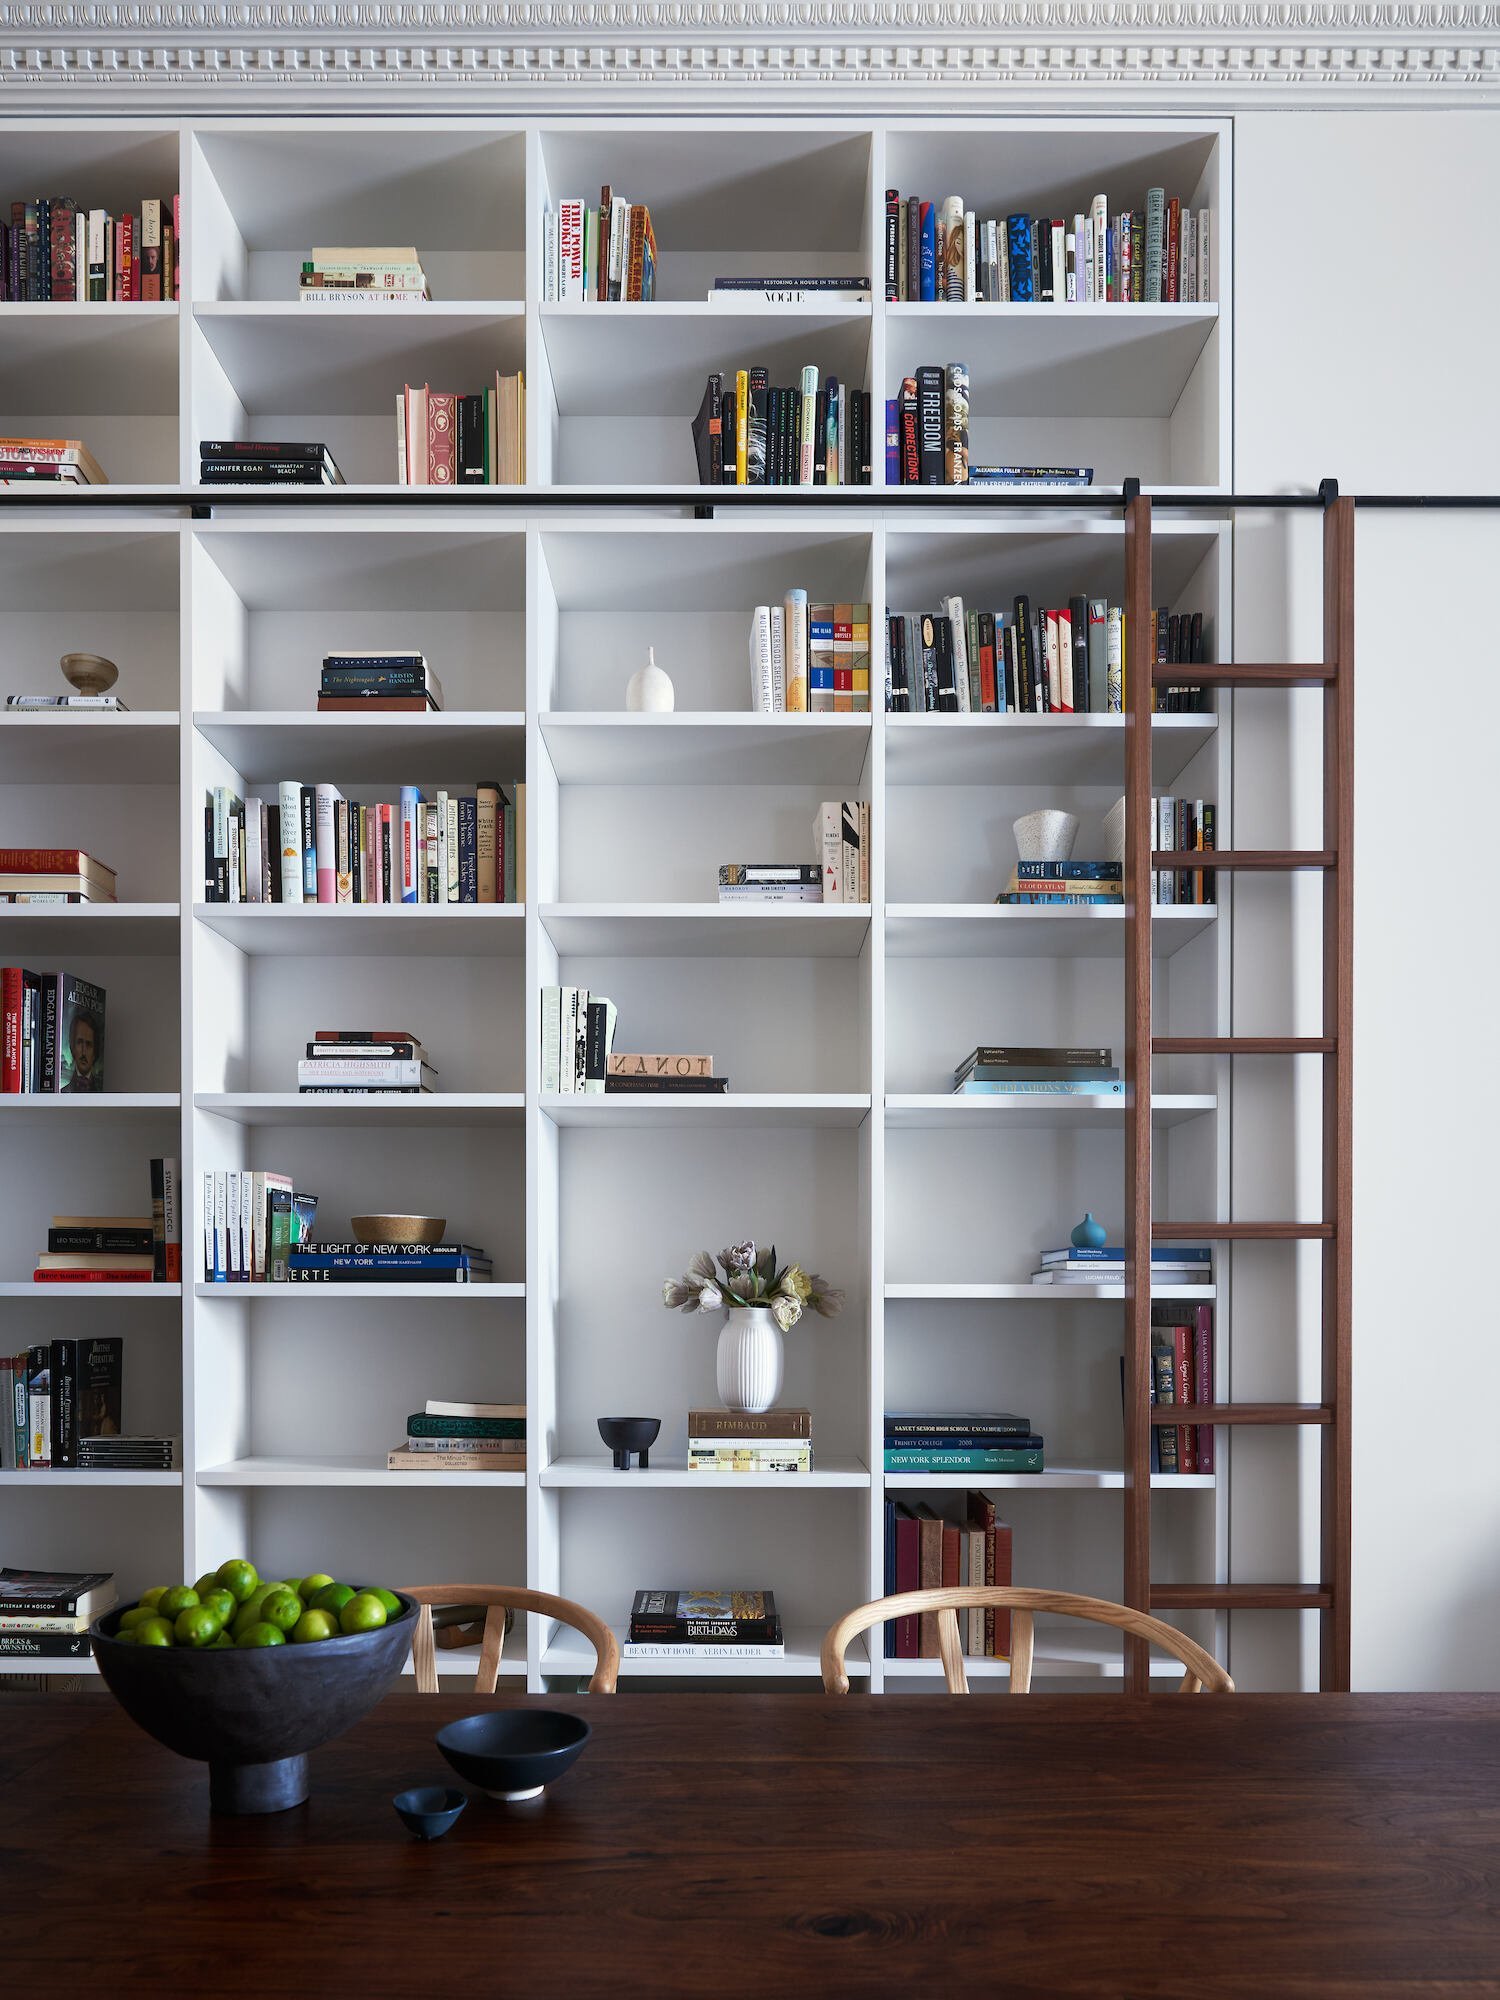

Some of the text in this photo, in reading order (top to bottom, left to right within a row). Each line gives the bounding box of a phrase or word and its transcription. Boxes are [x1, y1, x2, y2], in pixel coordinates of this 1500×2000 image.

[123, 224, 131, 253] TALK
[561, 205, 571, 258] BROKER
[571, 202, 581, 279] THE POWER
[889, 224, 897, 244] PERSON
[1150, 194, 1161, 272] DARK MATTER BLAKE
[889, 255, 897, 280] INTEREST
[804, 398, 812, 442] MOONWALKING
[923, 392, 941, 452] FREEDOM
[904, 413, 919, 481] CORRECTIONS
[953, 442, 963, 485] FRANZEN
[773, 615, 781, 664] MOTHERHOOD
[760, 614, 772, 709] MOTHERHOOD SHEILA HETI
[460, 861, 468, 883] Exley
[45, 989, 55, 1076] EDGAR ALLAN POE
[1018, 1084, 1060, 1092] AARONS
[296, 1244, 317, 1253] THE
[320, 1244, 351, 1253] LIGHT
[355, 1244, 370, 1254] OF
[373, 1245, 398, 1254] NEW
[401, 1245, 431, 1254] YORK
[291, 1269, 330, 1280] ERTE
[1180, 1360, 1190, 1382] Goya's
[716, 1421, 767, 1430] RIMBAUD
[687, 1626, 738, 1636] BIRTHDAYS
